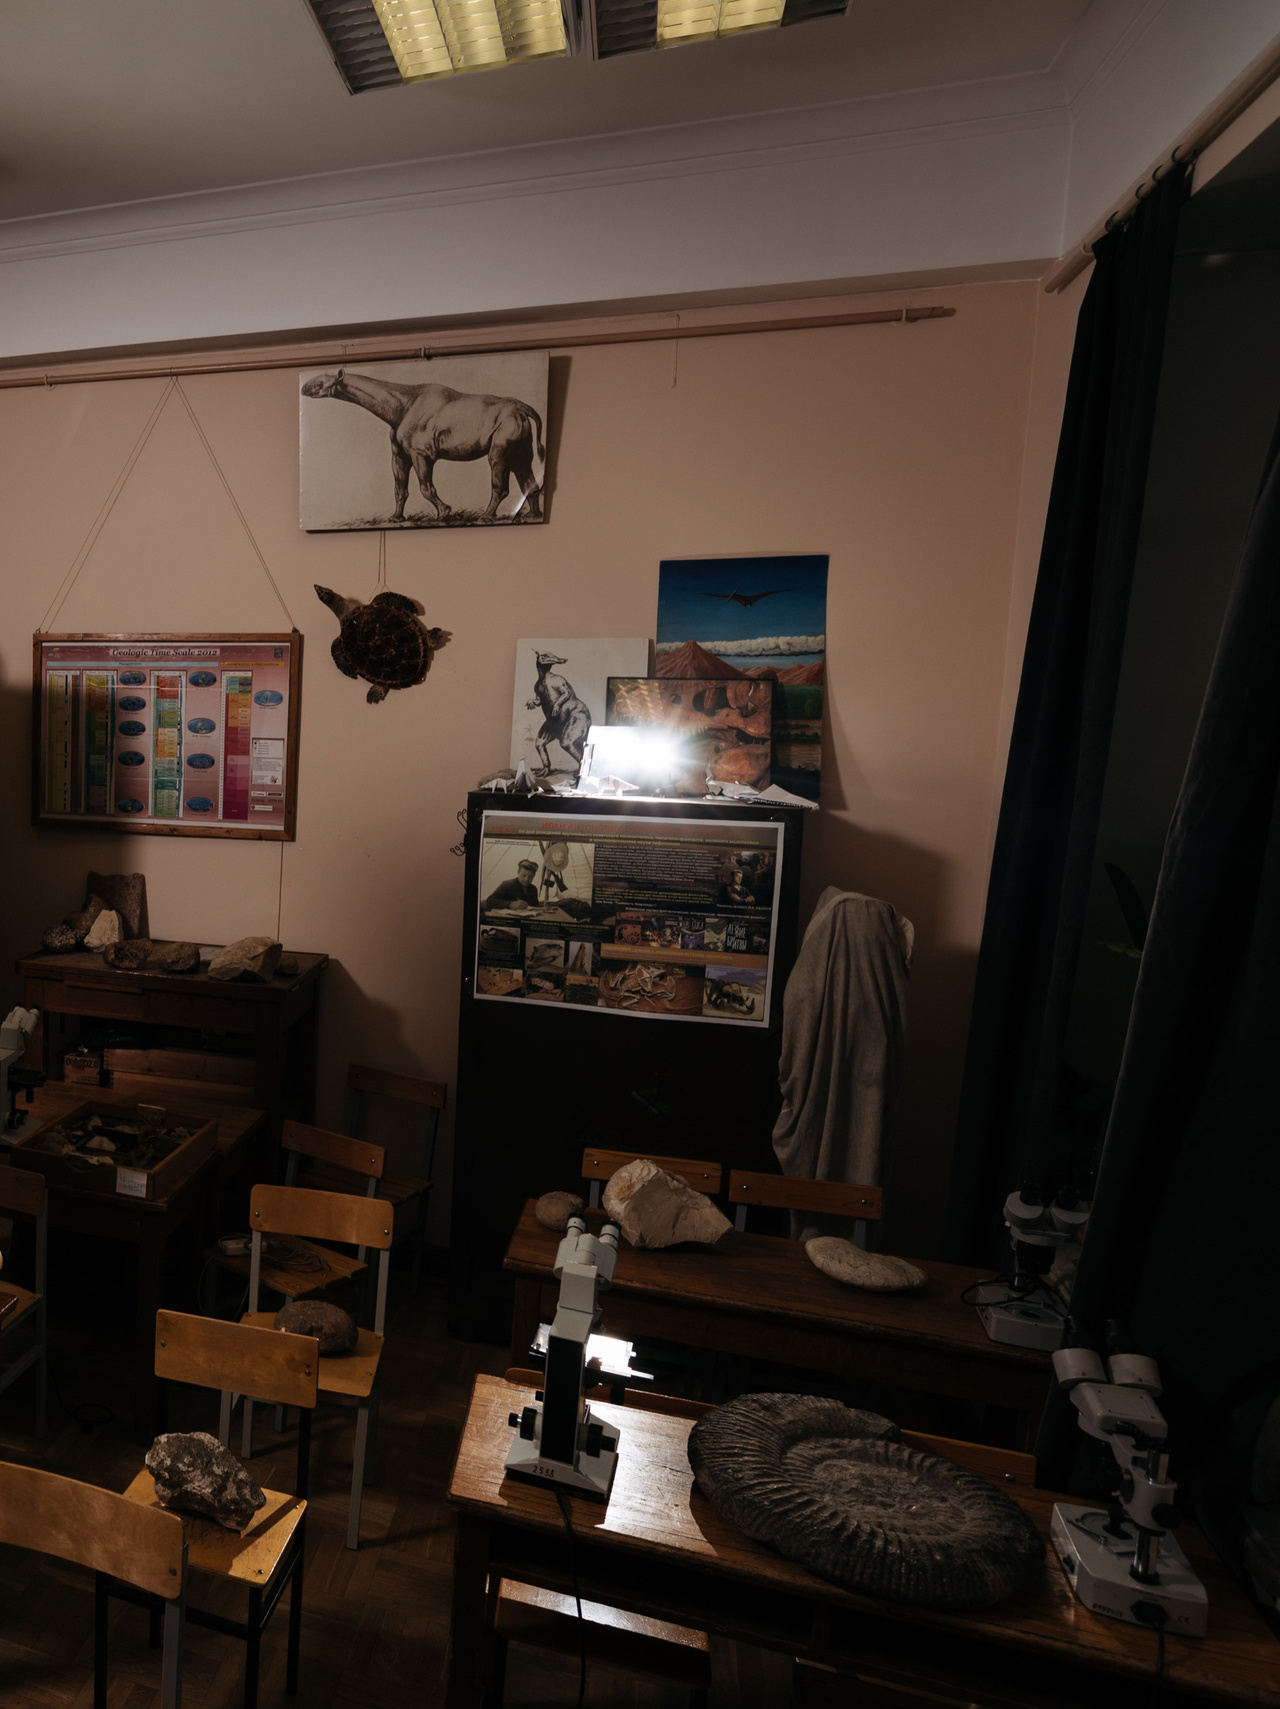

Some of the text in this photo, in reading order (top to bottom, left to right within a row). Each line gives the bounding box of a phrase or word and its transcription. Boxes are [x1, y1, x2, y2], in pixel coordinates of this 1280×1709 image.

[112, 648, 148, 658] Geologic
[150, 648, 171, 656] Time
[173, 648, 196, 656] Scale
[541, 821, 565, 830] ИВАН
[568, 823, 623, 833] АНТОНОВИЧ
[727, 923, 748, 938] ЛЕЗВИЕ
[726, 935, 747, 951] БРИТВЫ
[532, 1465, 555, 1478] 2538
